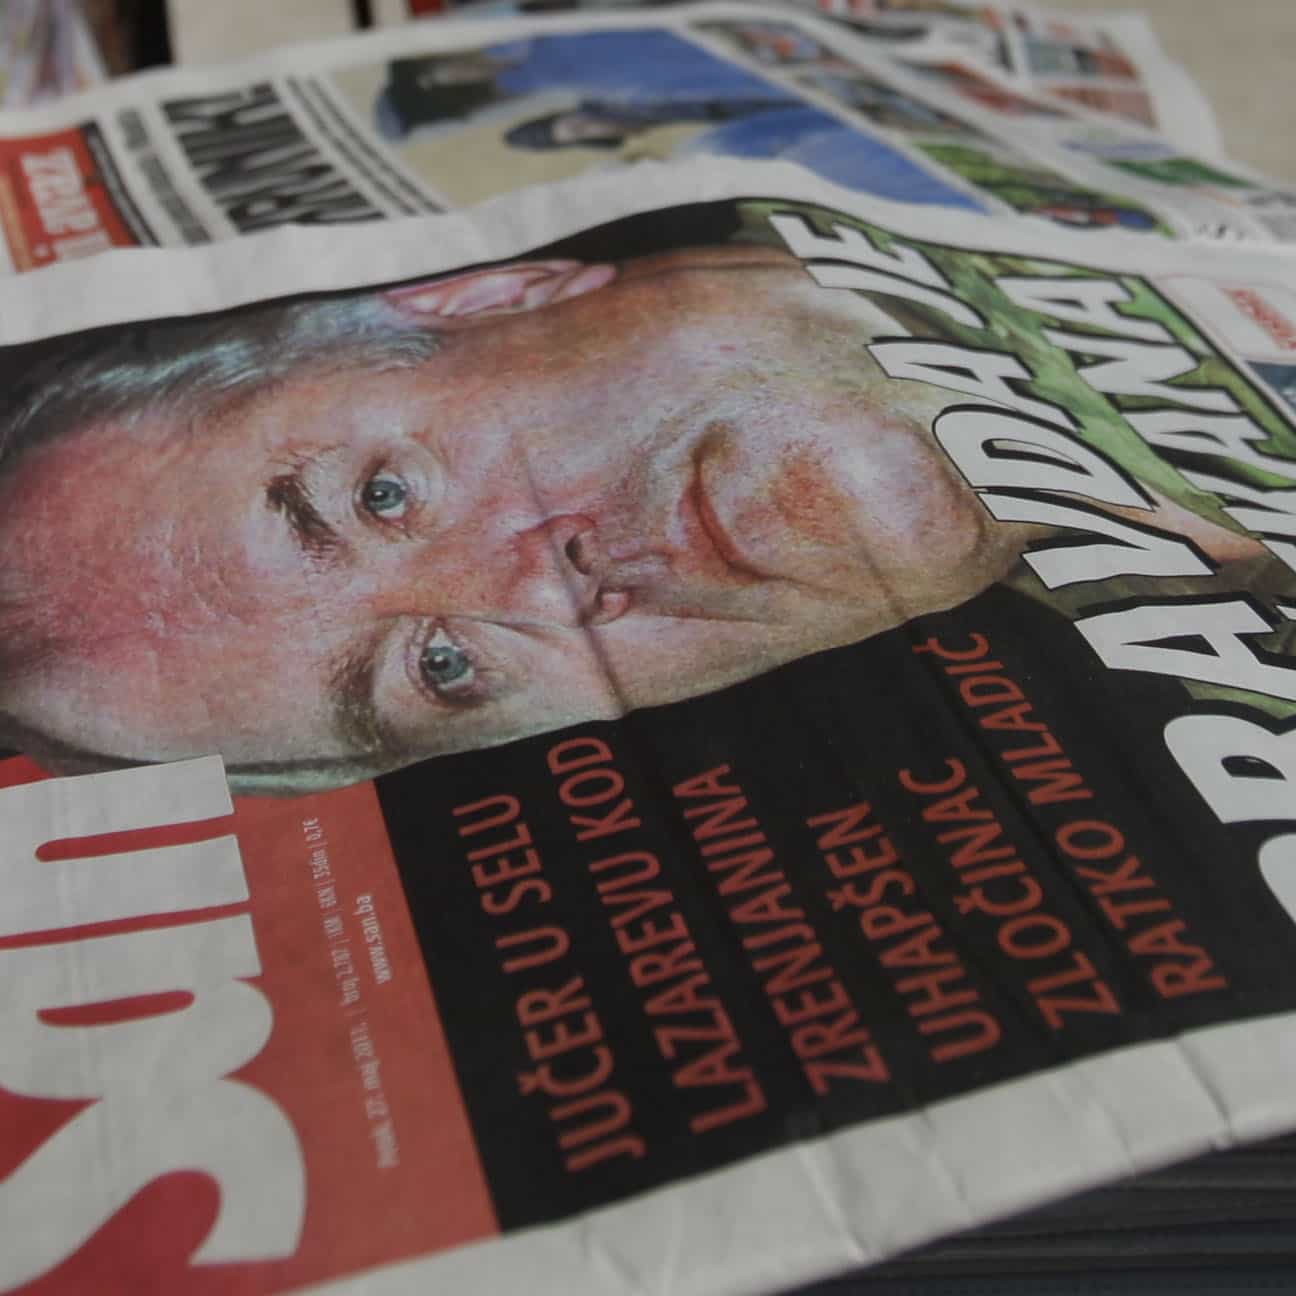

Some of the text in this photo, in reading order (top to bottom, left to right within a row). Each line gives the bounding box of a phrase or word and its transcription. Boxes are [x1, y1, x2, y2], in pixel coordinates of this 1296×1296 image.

[354, 894, 392, 985] www.san.ba
[452, 792, 645, 1174] JUČER U SELU
[546, 734, 769, 1136] LAZAREVU KOD
[672, 762, 893, 1098] ZRENJANINA
[807, 801, 1003, 1066] UHAPŠEN
[899, 756, 1123, 1033] ZLOČINAC
[1054, 818, 1232, 1004] RATKO
